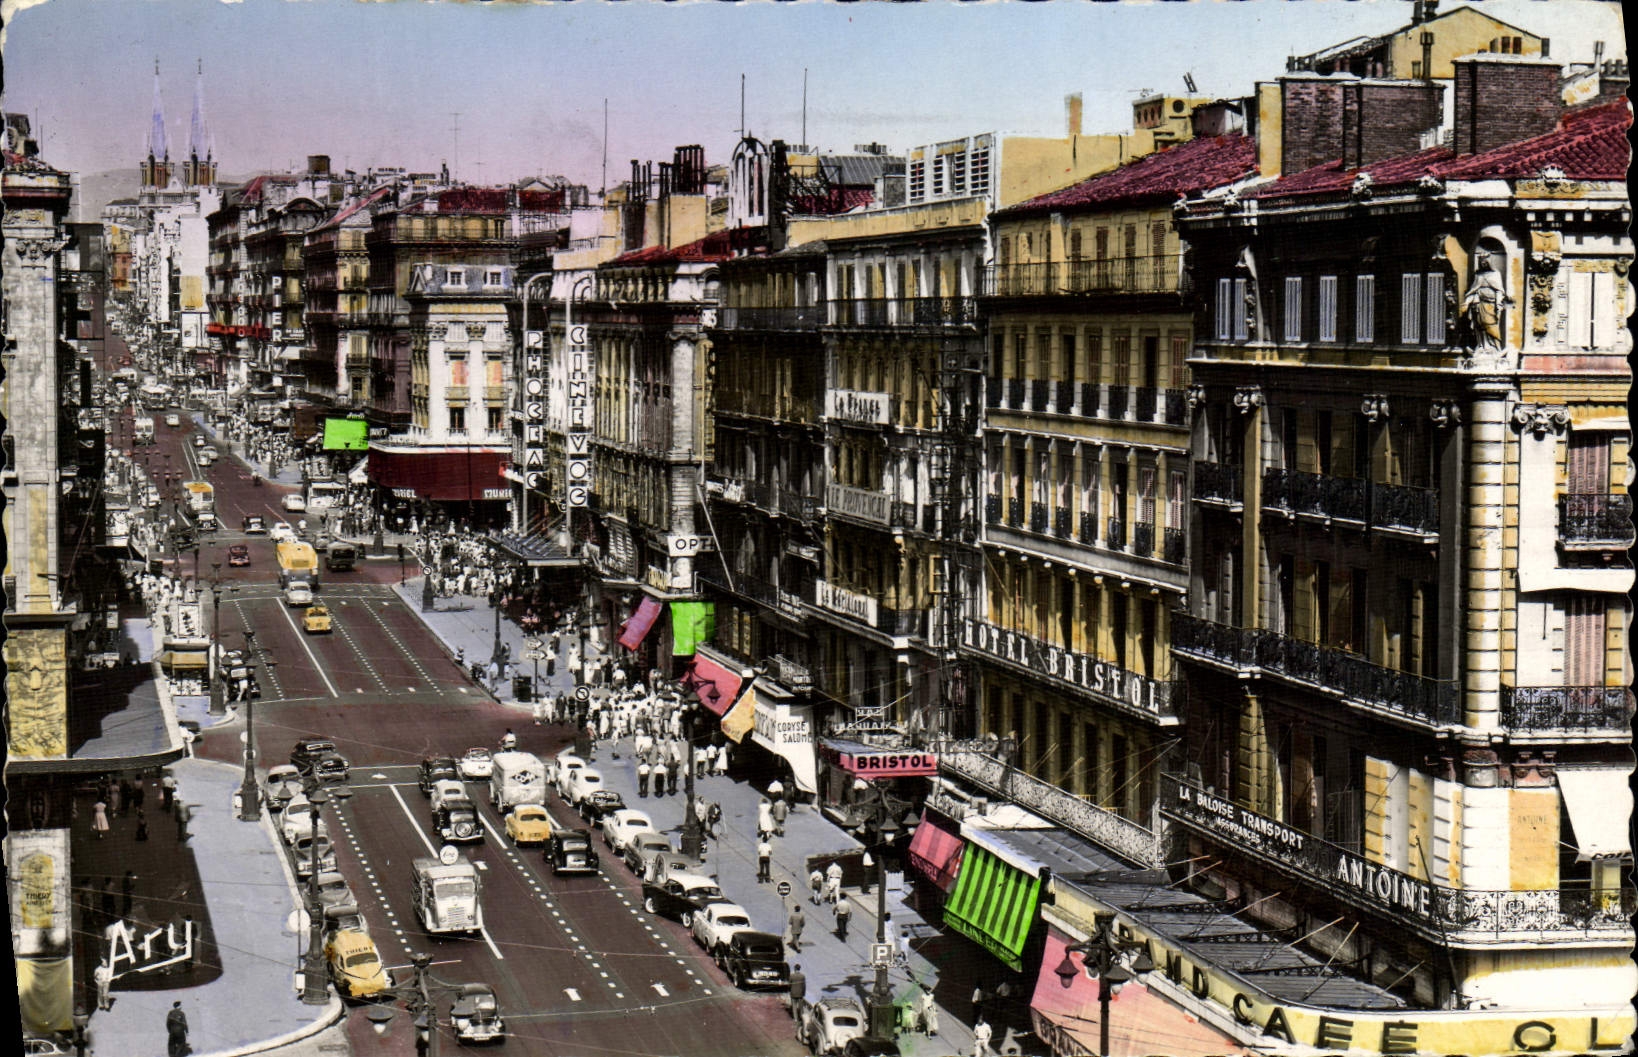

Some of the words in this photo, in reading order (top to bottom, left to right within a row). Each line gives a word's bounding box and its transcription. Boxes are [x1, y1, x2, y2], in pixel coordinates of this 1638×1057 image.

[1049, 647, 1159, 714] BRISTOL
[857, 754, 932, 769] BRISTOL
[1179, 786, 1190, 800] LA
[1197, 793, 1234, 819] BALOISE
[1241, 811, 1303, 849] TRANSPORT
[877, 946, 888, 960] P
